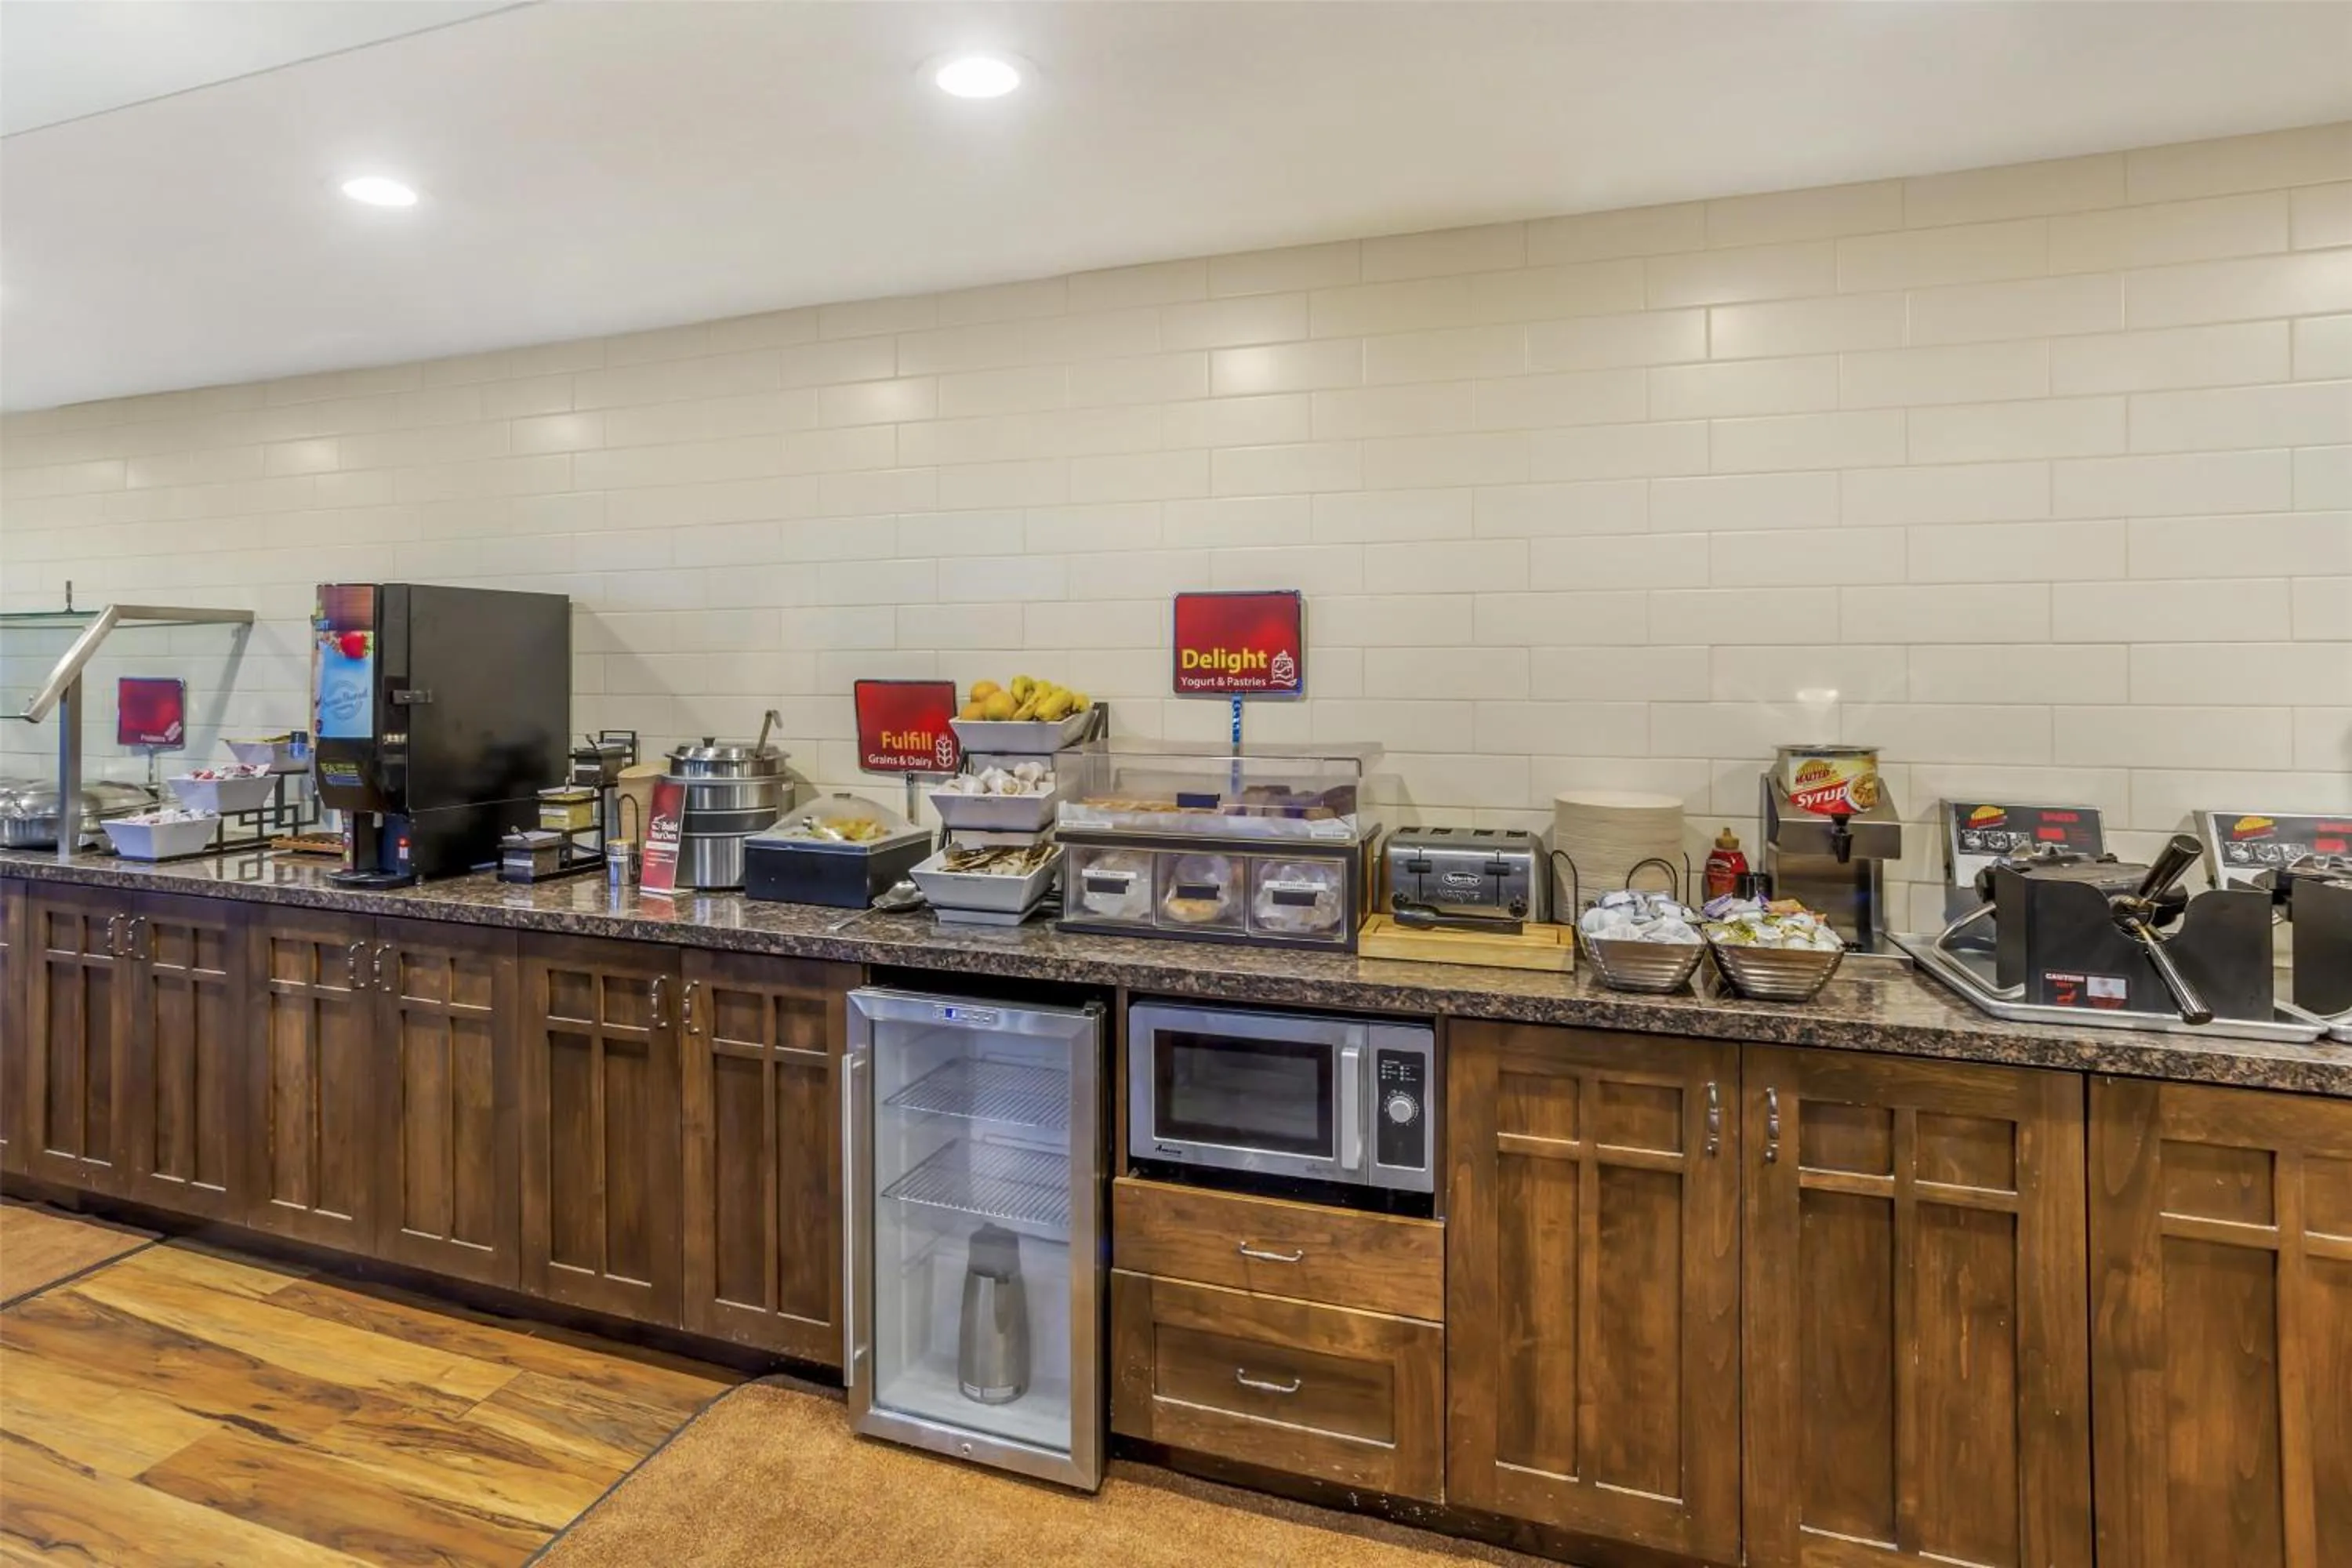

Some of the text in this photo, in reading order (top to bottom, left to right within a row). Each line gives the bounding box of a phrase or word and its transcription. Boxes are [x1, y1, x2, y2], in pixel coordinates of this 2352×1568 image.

[1181, 648, 1268, 673] Delight
[1181, 677, 1266, 688] Yogurt & Pastries
[881, 731, 932, 750] Fulfill
[868, 753, 932, 768] Grains & Dairy
[1797, 786, 1848, 808] Syrup
[661, 821, 678, 832] Build
[662, 831, 677, 840] Own
